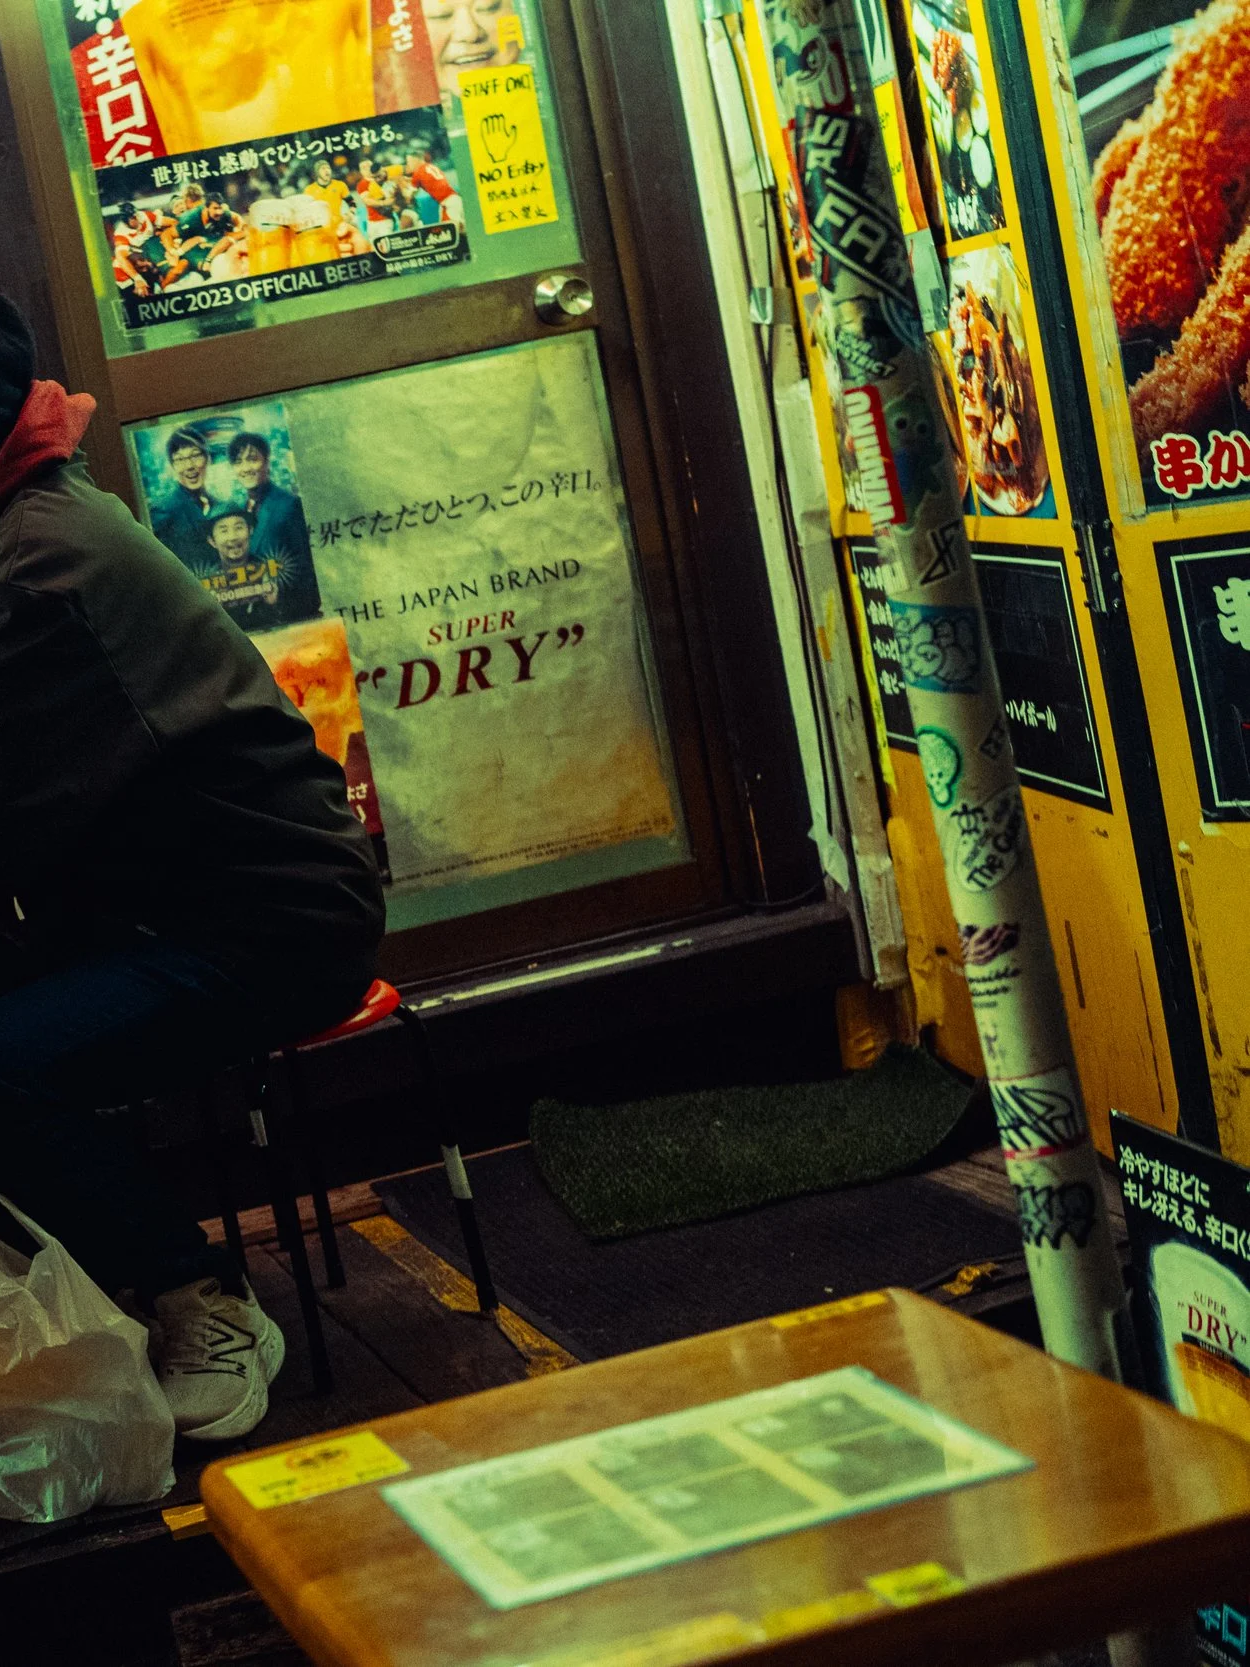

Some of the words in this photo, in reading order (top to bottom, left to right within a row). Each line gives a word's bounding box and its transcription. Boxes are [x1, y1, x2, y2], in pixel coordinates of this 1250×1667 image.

[462, 78, 500, 98] STAFF
[151, 124, 405, 188] 世界は、感動でひとつになれる。
[478, 168, 502, 184] NO
[138, 295, 183, 322] RWC
[187, 286, 233, 313] 2023
[235, 268, 322, 303] OFFICIAL
[325, 259, 372, 288] BEER
[334, 599, 385, 624] THE
[397, 578, 480, 616] JAPAN
[490, 556, 581, 594] BRAND
[427, 609, 516, 647] SUPER
[1119, 1143, 1211, 1209] 冷やすほどに
[1193, 1290, 1228, 1317] SUPER
